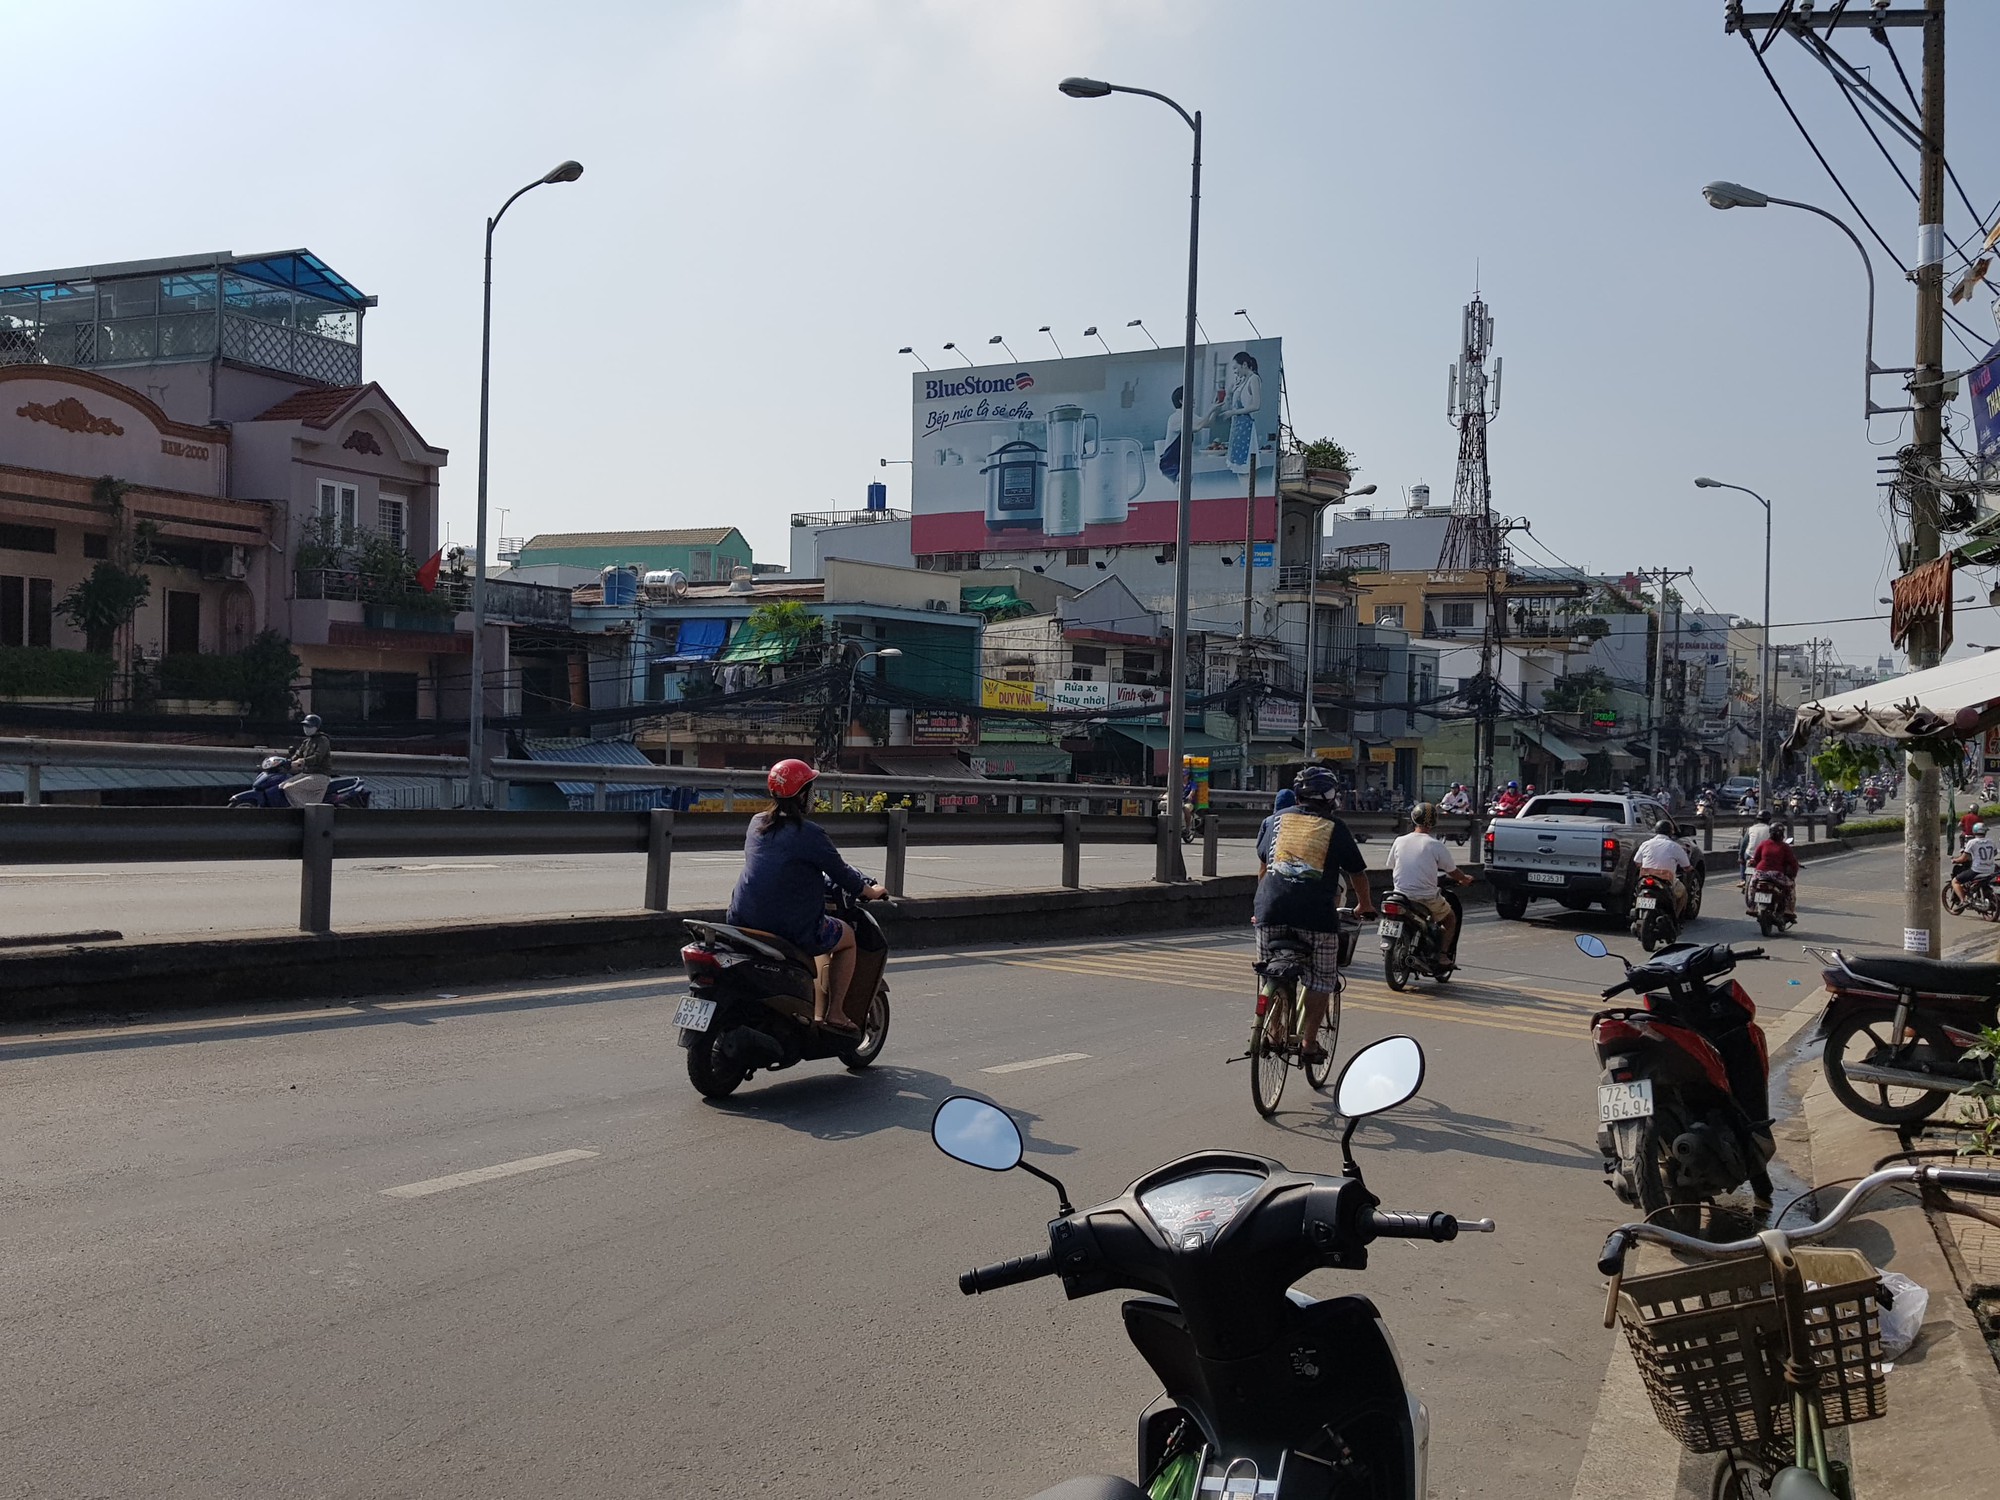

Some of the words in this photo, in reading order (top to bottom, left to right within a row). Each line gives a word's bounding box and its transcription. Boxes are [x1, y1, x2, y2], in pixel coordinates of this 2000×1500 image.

[925, 376, 1014, 399] BlueStone
[952, 405, 973, 420] núc
[976, 399, 990, 417] là
[1009, 401, 1034, 420] chia
[1086, 684, 1098, 692] xe
[999, 692, 1014, 705] DUY
[1057, 695, 1080, 705] Thay
[1979, 846, 1993, 860] 07
[1498, 856, 1597, 867] RANGER
[754, 963, 780, 973] LEAD
[675, 1012, 709, 1029] 887.43
[1607, 1083, 1643, 1102] 72-C1
[1602, 1098, 1650, 1119] 964.94
